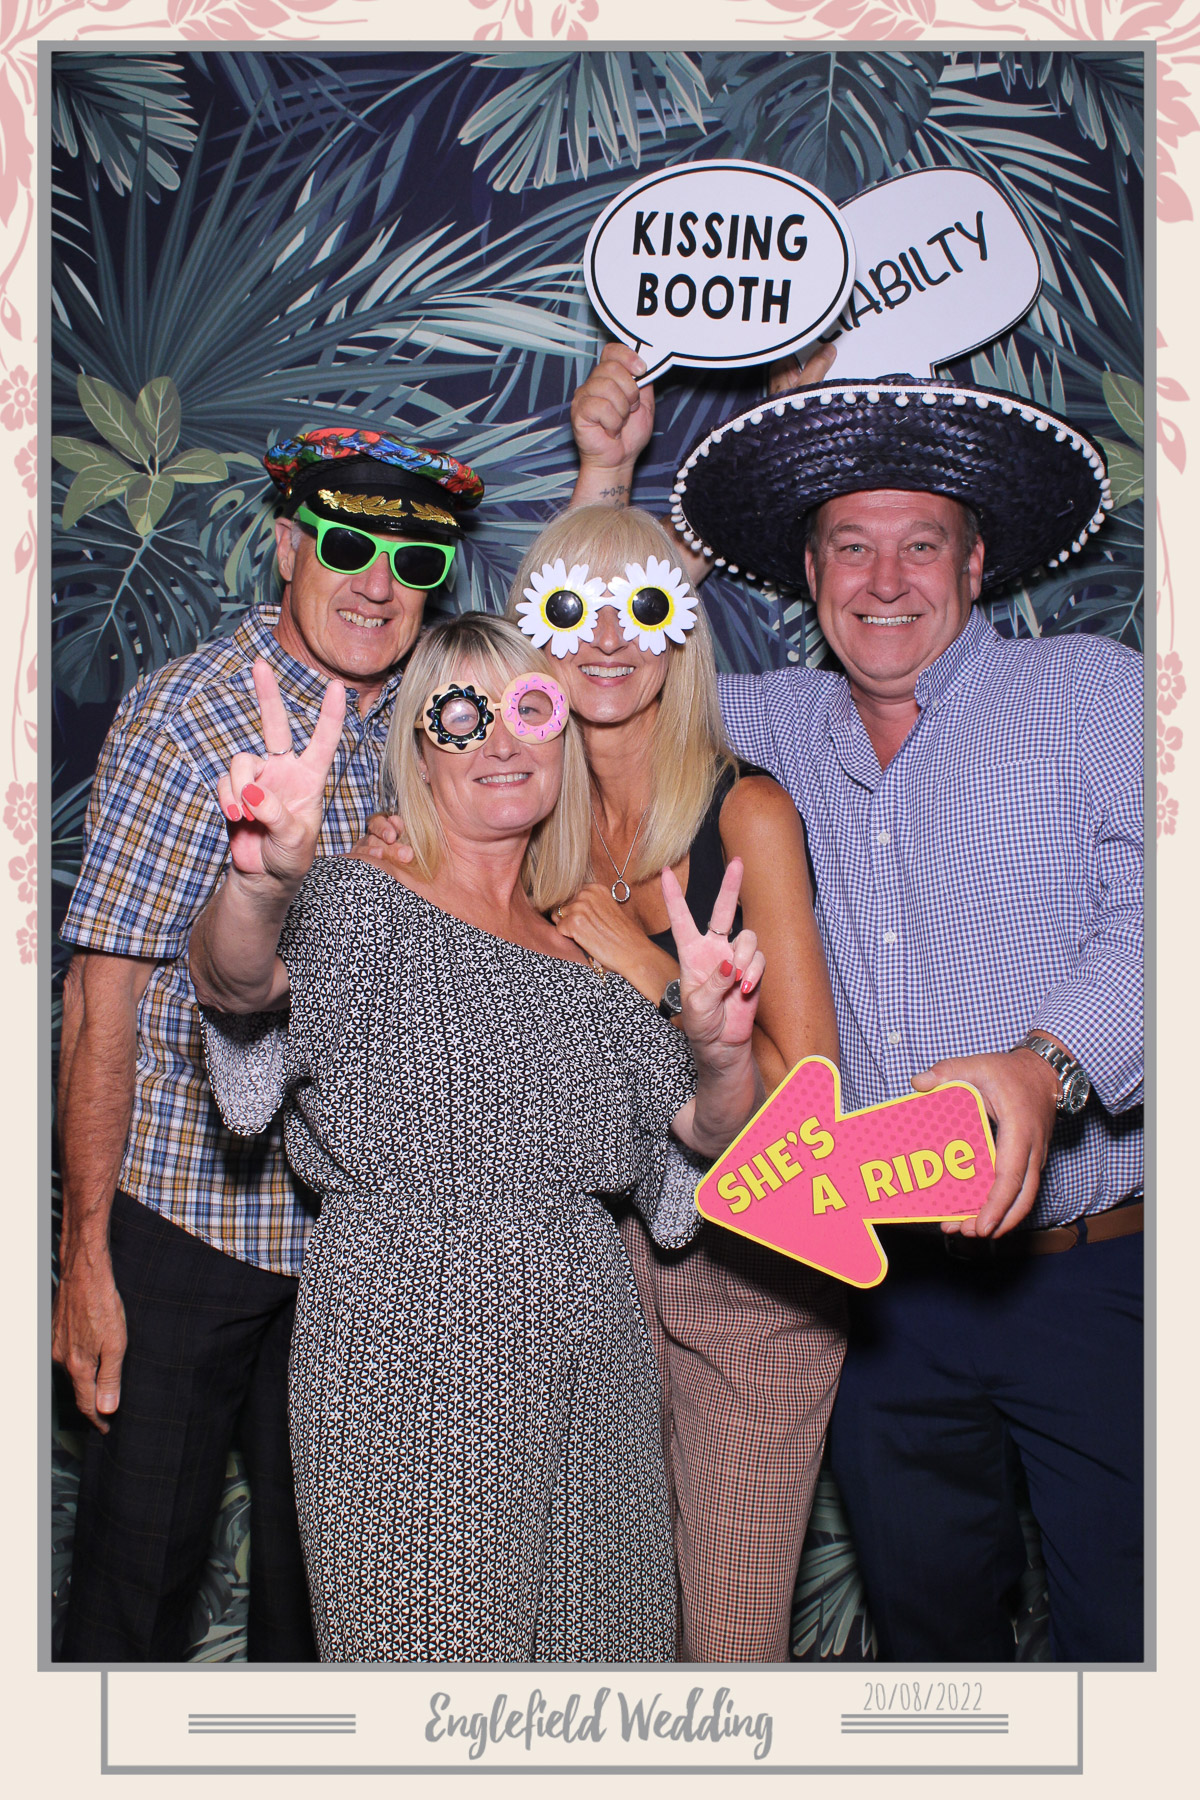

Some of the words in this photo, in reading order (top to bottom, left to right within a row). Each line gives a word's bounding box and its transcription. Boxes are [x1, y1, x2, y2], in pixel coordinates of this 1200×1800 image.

[632, 211, 808, 262] KISSING
[636, 272, 792, 324] BOOTH
[716, 1116, 835, 1215] SHE'S
[811, 1173, 847, 1215] A
